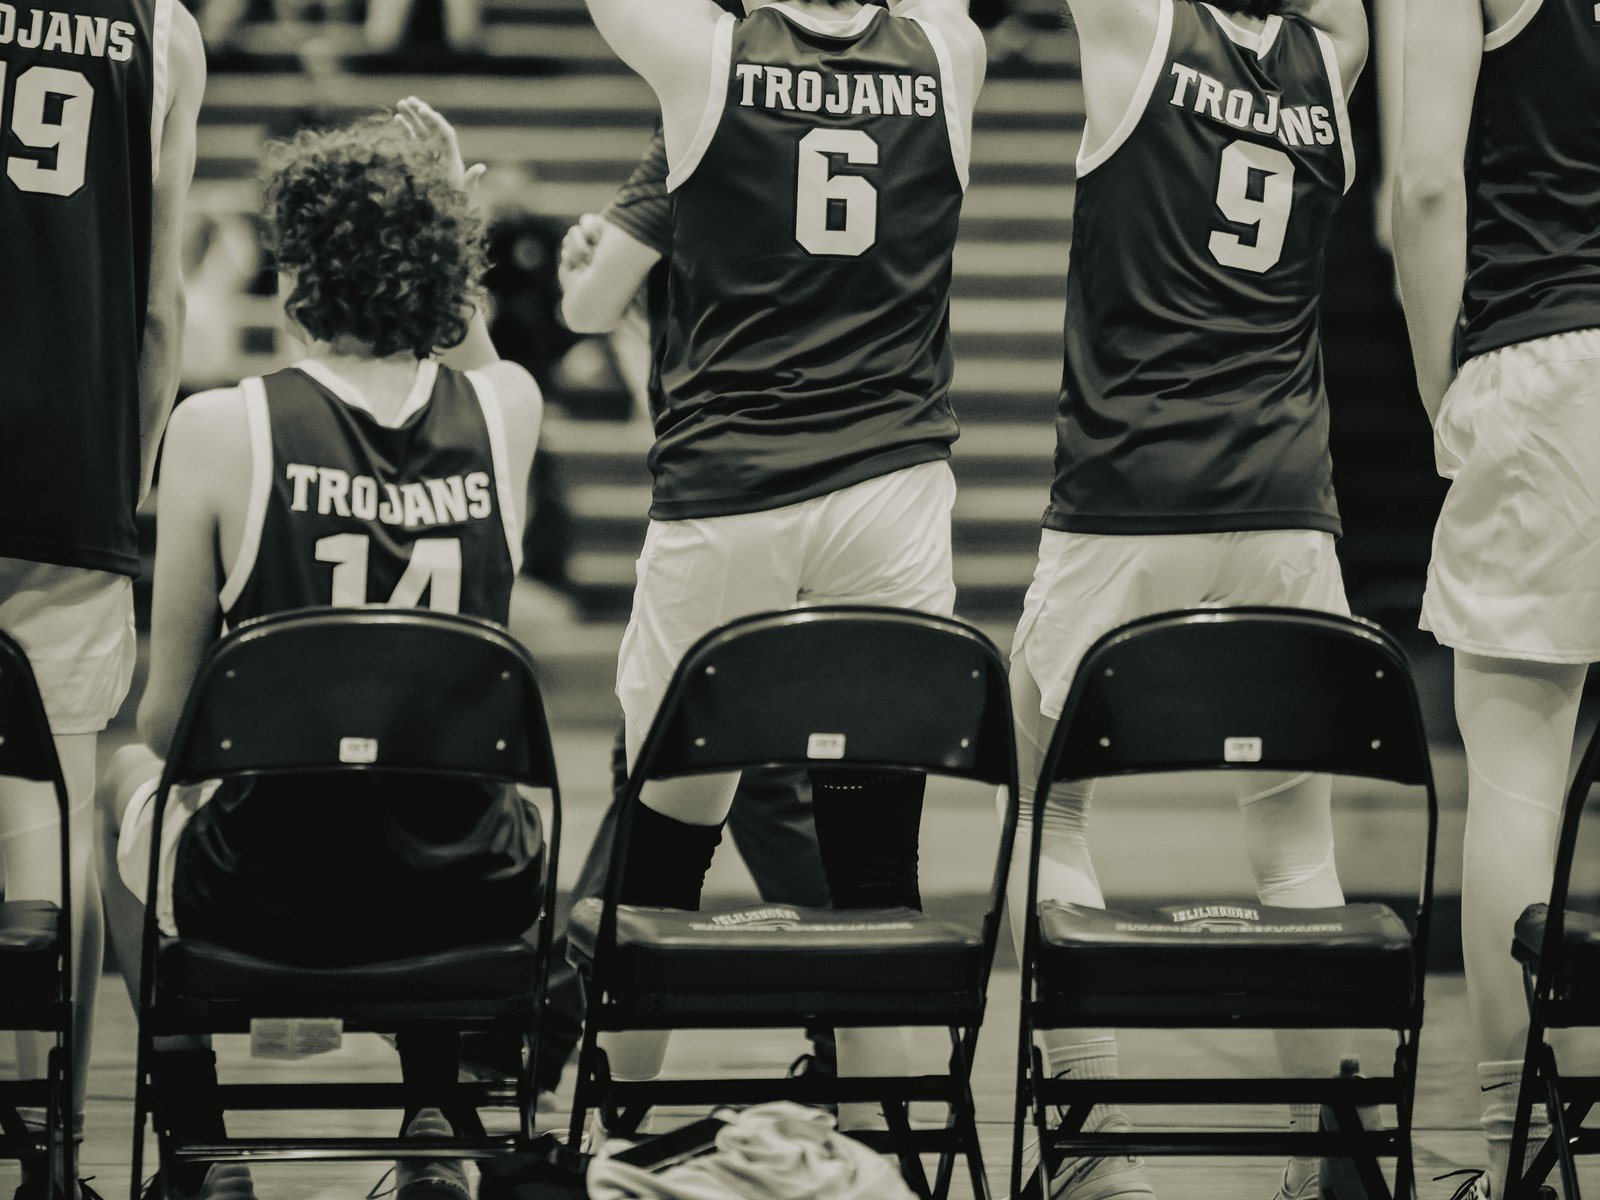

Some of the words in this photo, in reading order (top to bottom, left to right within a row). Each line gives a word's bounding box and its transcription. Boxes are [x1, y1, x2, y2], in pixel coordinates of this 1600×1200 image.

[0, 60, 95, 198] 9
[736, 63, 937, 118] TROJANS
[1169, 62, 1336, 146] TROJNS
[795, 127, 879, 257] 6
[1208, 139, 1296, 274] 9
[286, 463, 492, 528] TROJANS
[314, 532, 463, 616] 14
